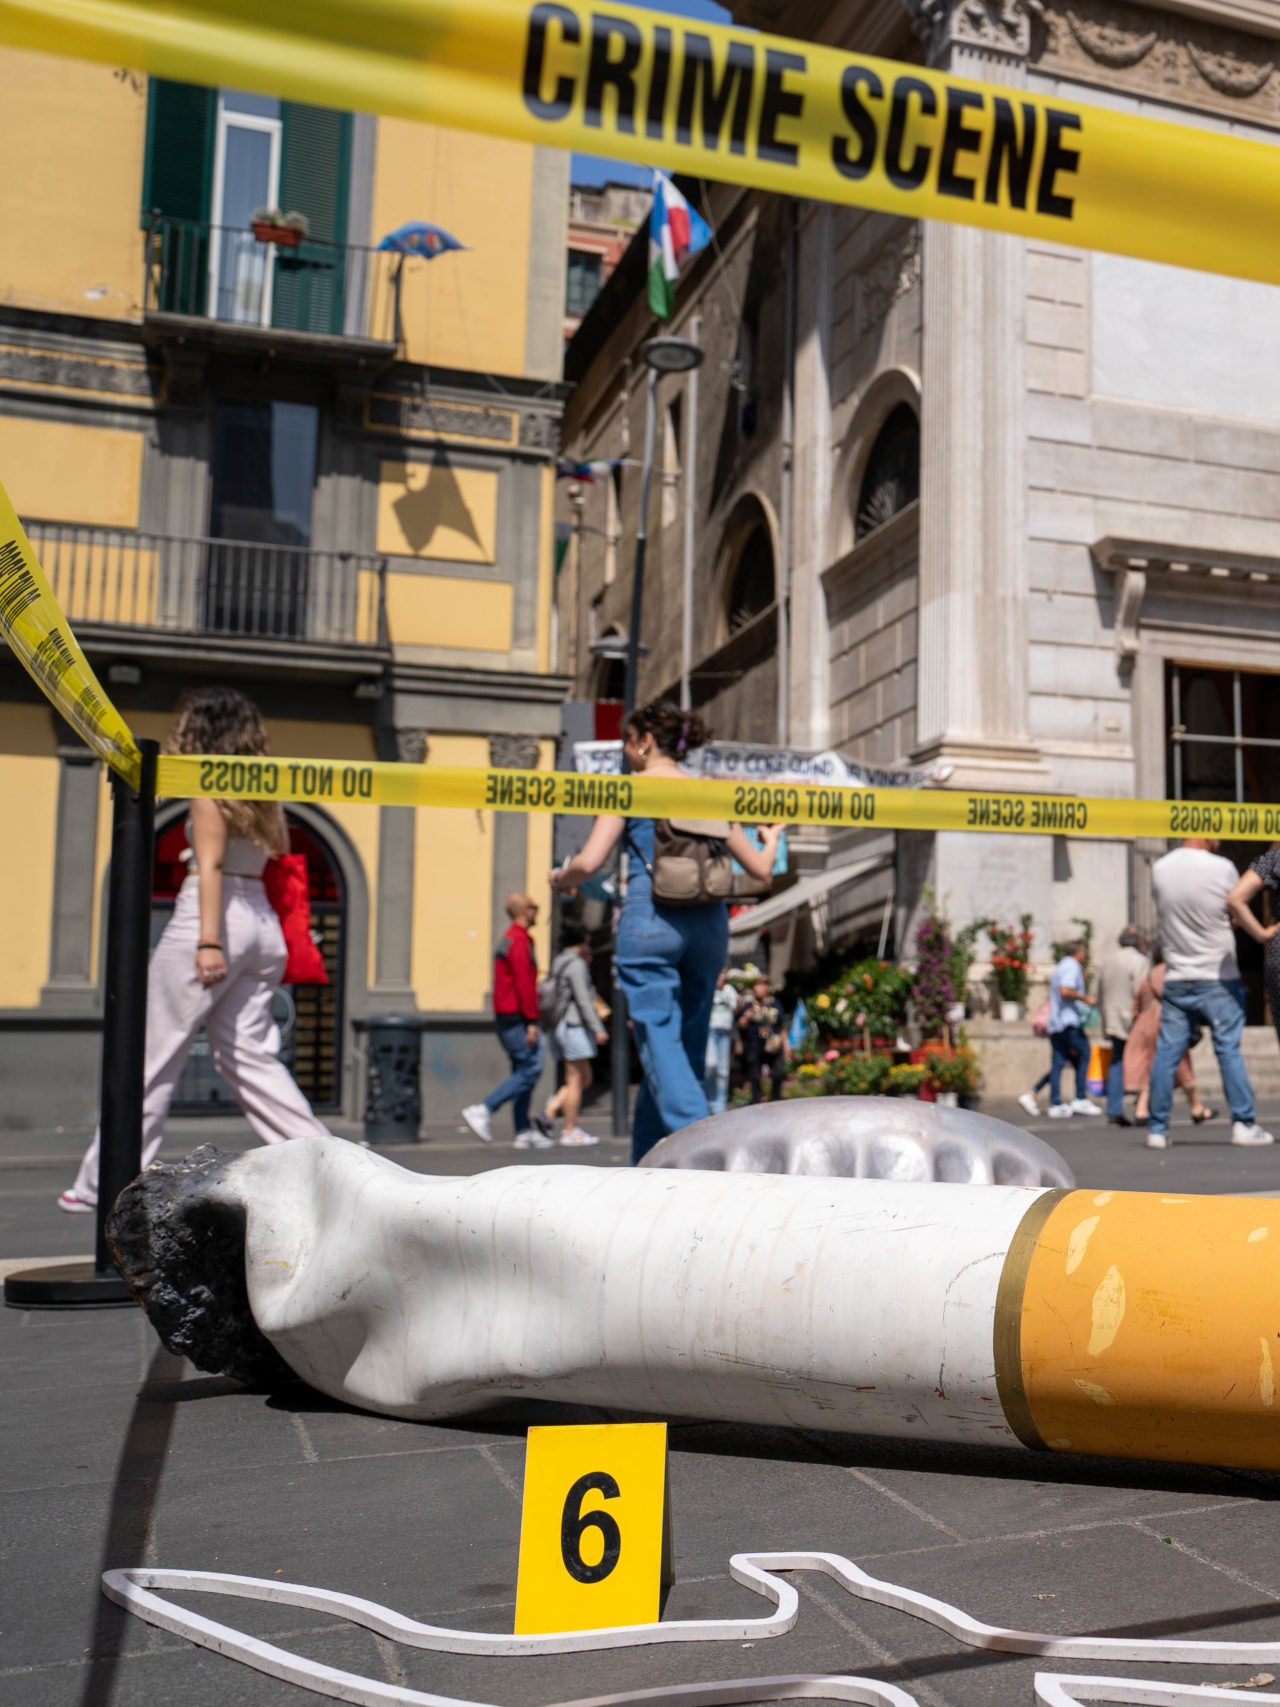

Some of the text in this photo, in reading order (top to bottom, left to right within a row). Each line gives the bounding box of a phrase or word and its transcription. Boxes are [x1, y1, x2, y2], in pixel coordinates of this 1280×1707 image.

[520, 2, 1083, 220] CRIME SCENE
[561, 1471, 621, 1584] 6
